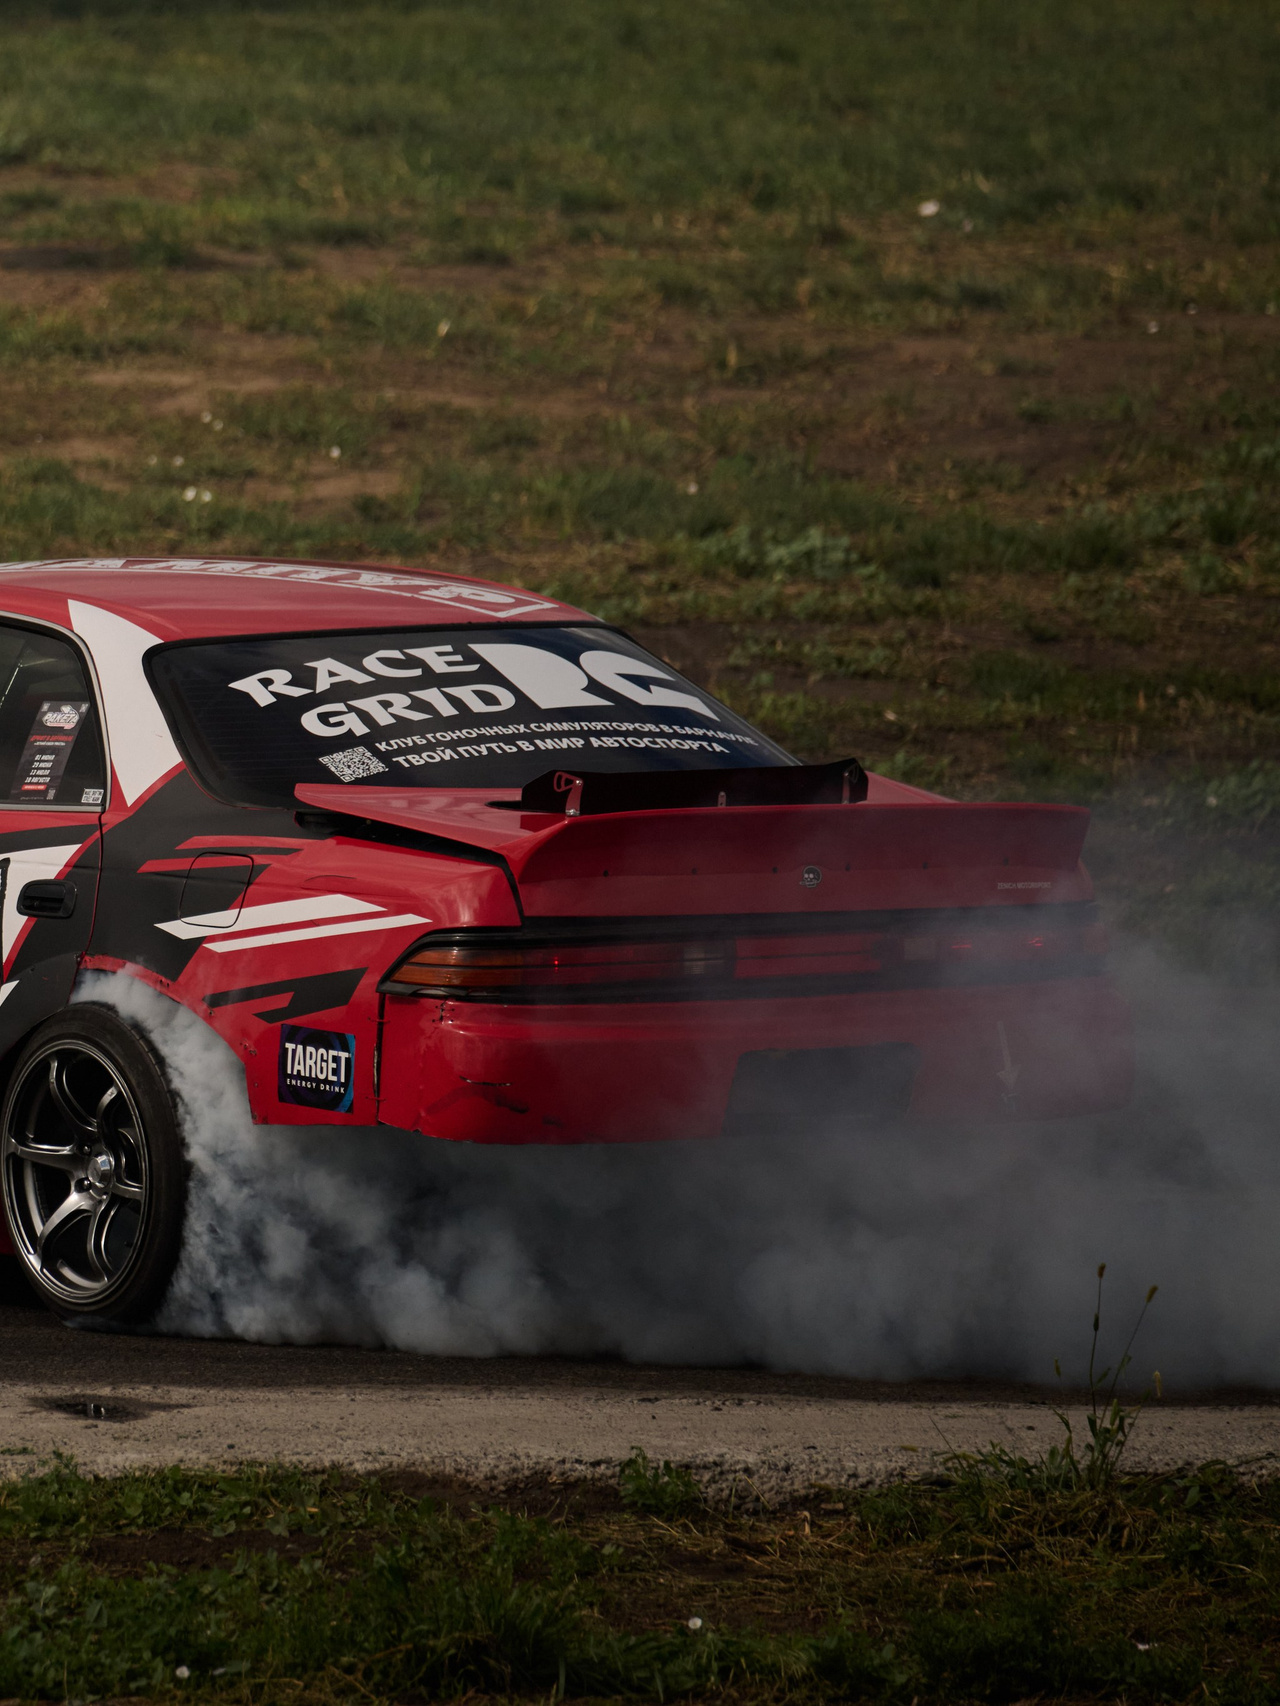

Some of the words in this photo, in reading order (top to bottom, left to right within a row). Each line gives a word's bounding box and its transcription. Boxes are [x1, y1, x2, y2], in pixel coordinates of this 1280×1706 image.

[228, 645, 481, 707] RACE
[300, 683, 516, 737] GRID
[375, 735, 427, 752] КЛУБ
[426, 724, 532, 743] ГОНОЧНЫХ
[530, 721, 660, 733] СИМУЛЯТОРОВ
[658, 725, 673, 733] В
[671, 725, 759, 746] БАРНАУЛЕ
[392, 746, 460, 768] ТВОЙ
[456, 742, 519, 758] ПУТЬ
[516, 740, 535, 751] В
[534, 737, 586, 750] МИР
[589, 737, 731, 753] АВТОСПОРТА
[284, 1042, 349, 1083] TARGET
[286, 1079, 317, 1089] ENERGY
[320, 1083, 345, 1094] DRINK
